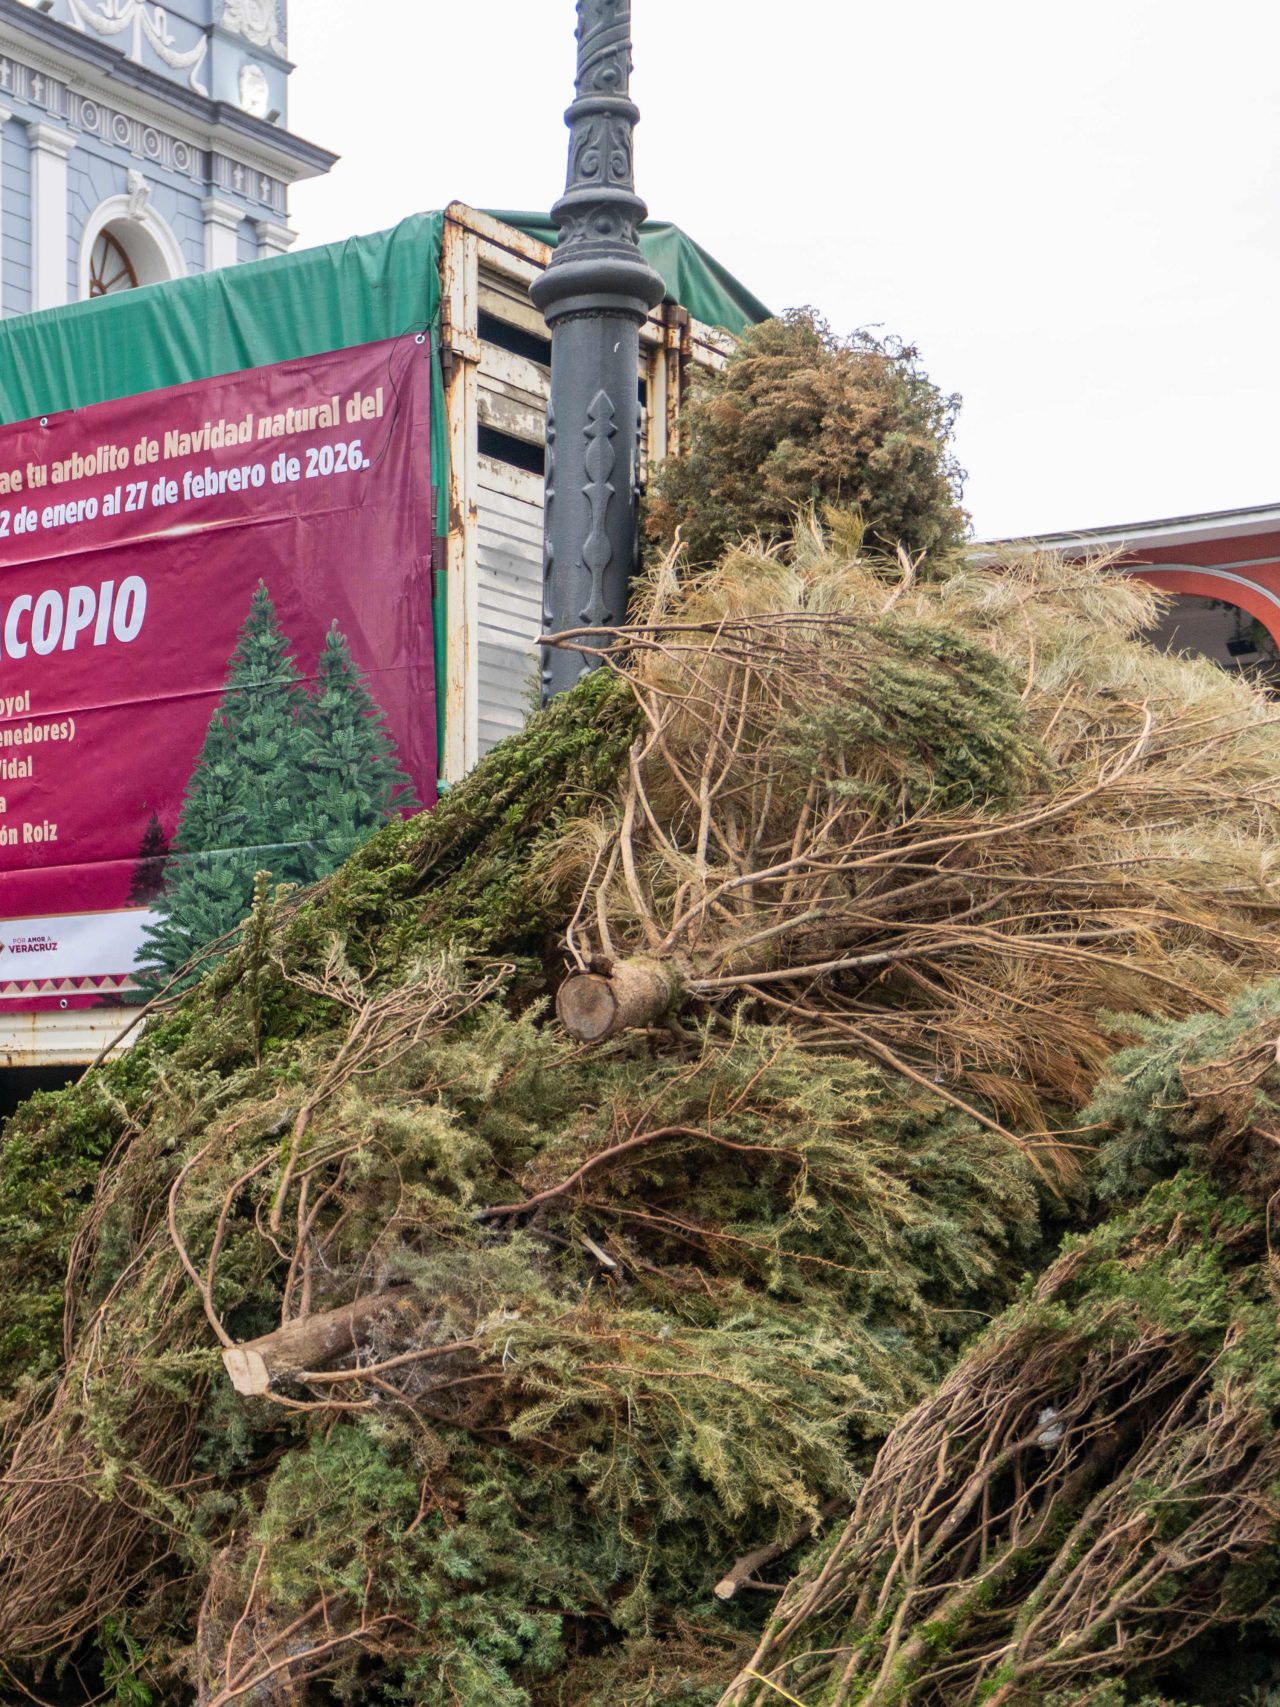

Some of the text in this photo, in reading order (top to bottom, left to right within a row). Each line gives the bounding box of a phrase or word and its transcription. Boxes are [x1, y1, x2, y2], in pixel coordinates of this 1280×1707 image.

[26, 463, 47, 489] tu
[51, 445, 129, 484] arbolito
[133, 436, 159, 466] de
[163, 414, 253, 459] Navidad
[257, 395, 340, 440] natural
[346, 387, 384, 423] del
[14, 506, 37, 534] de
[41, 497, 98, 529] enero
[102, 486, 121, 517] al
[125, 481, 148, 512] 27
[151, 476, 178, 506] de
[183, 463, 265, 500] febrero
[271, 453, 300, 484] de
[305, 440, 370, 478] 2026.
[23, 820, 58, 843] Roiz
[8, 942, 58, 954] VERACRUZ
